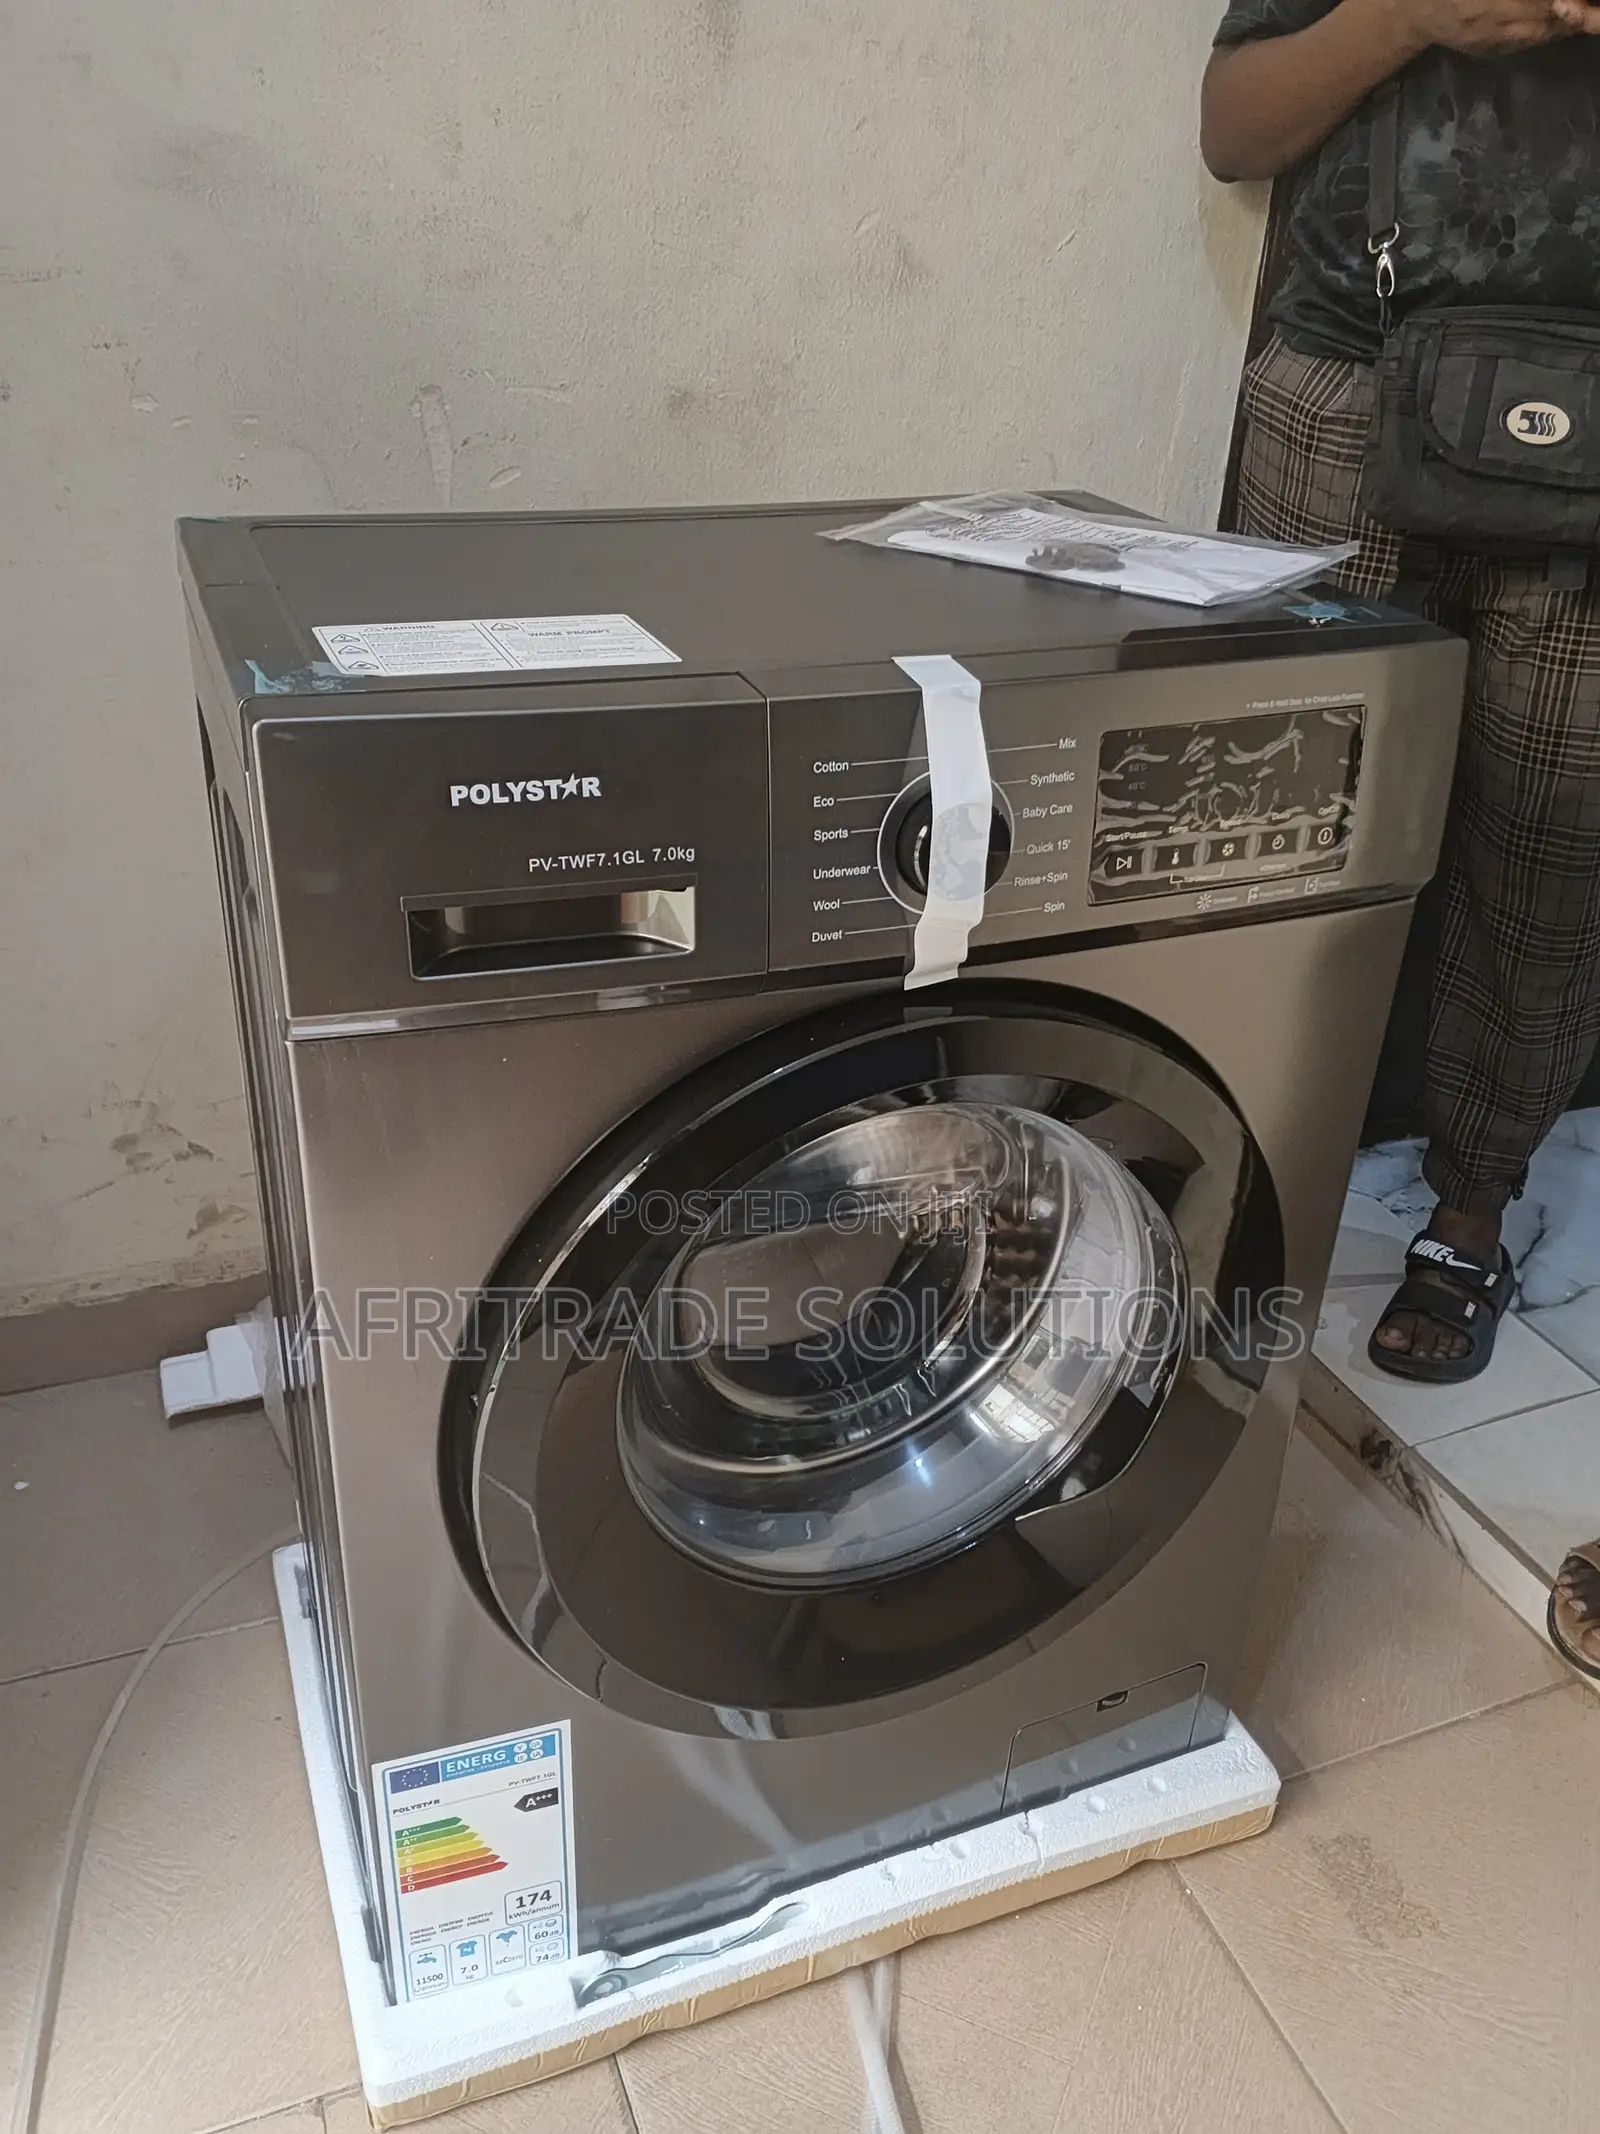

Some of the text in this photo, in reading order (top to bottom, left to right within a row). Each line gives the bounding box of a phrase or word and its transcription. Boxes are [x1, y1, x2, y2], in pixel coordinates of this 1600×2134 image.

[1058, 738, 1077, 749] Mix
[813, 761, 849, 773] Cotton
[1030, 770, 1075, 786] Synthetic
[813, 796, 834, 808] Eco
[1022, 803, 1073, 819] Baby Care
[813, 828, 849, 842] Sports
[1026, 842, 1054, 855] Quick
[528, 846, 695, 872] PV-TWF7.1GL 7.0kg
[813, 864, 871, 880] Underwear
[1014, 872, 1068, 888] Rinse+Spin
[813, 898, 840, 911] Wool
[1044, 901, 1066, 913] Spin
[812, 929, 842, 942] Duvet
[1411, 1239, 1455, 1262] NIKE
[446, 1749, 507, 1773] ENERG
[516, 1889, 552, 1909] 174
[509, 1903, 560, 1920] kWh/annum
[534, 1930, 548, 1940] 60
[536, 1953, 549, 1963] 74
[460, 1964, 479, 1974] 7.0
[416, 1973, 444, 1986] 11500
